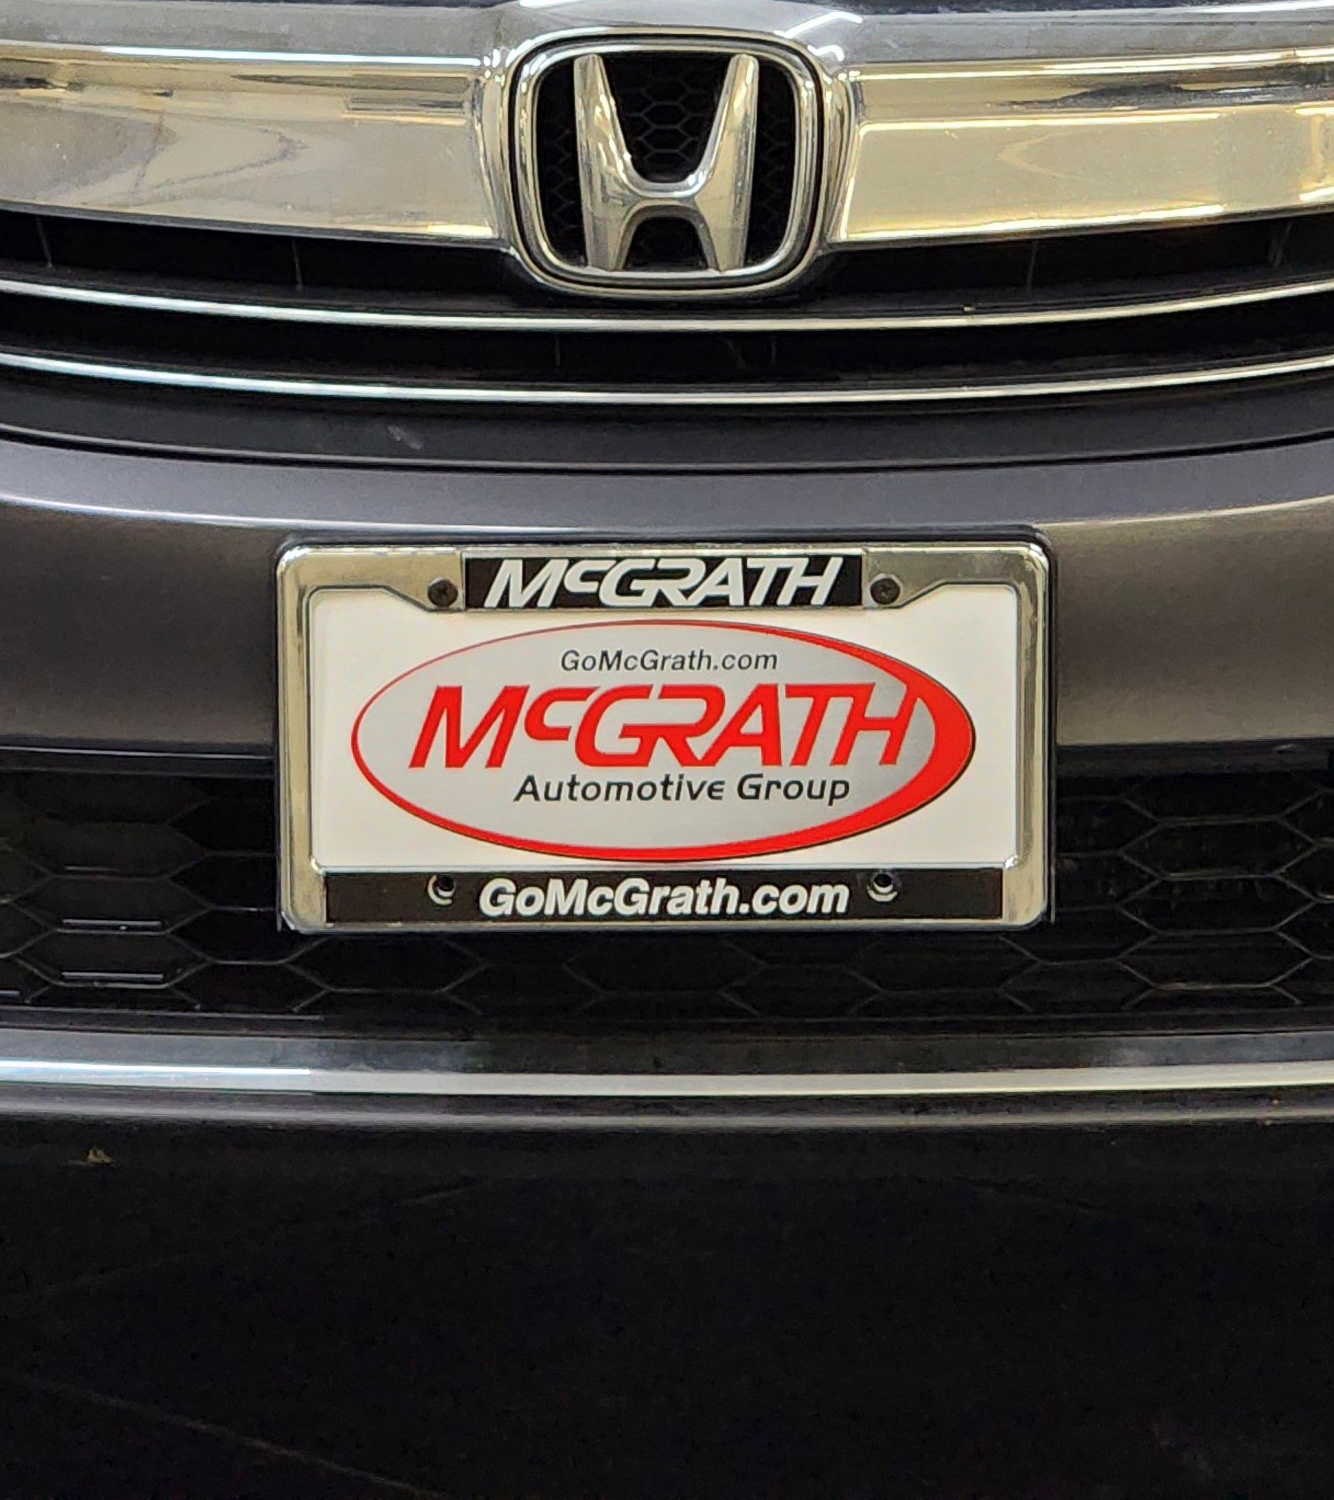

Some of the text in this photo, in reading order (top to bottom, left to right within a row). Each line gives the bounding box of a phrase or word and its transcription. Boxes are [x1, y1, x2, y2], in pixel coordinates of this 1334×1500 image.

[483, 556, 843, 607] McGRATH
[561, 649, 778, 671] GoMcGrath.com
[409, 683, 915, 768] McGRATH
[513, 773, 849, 806] Automotive Group
[479, 877, 850, 916] GoMcGrath.com
